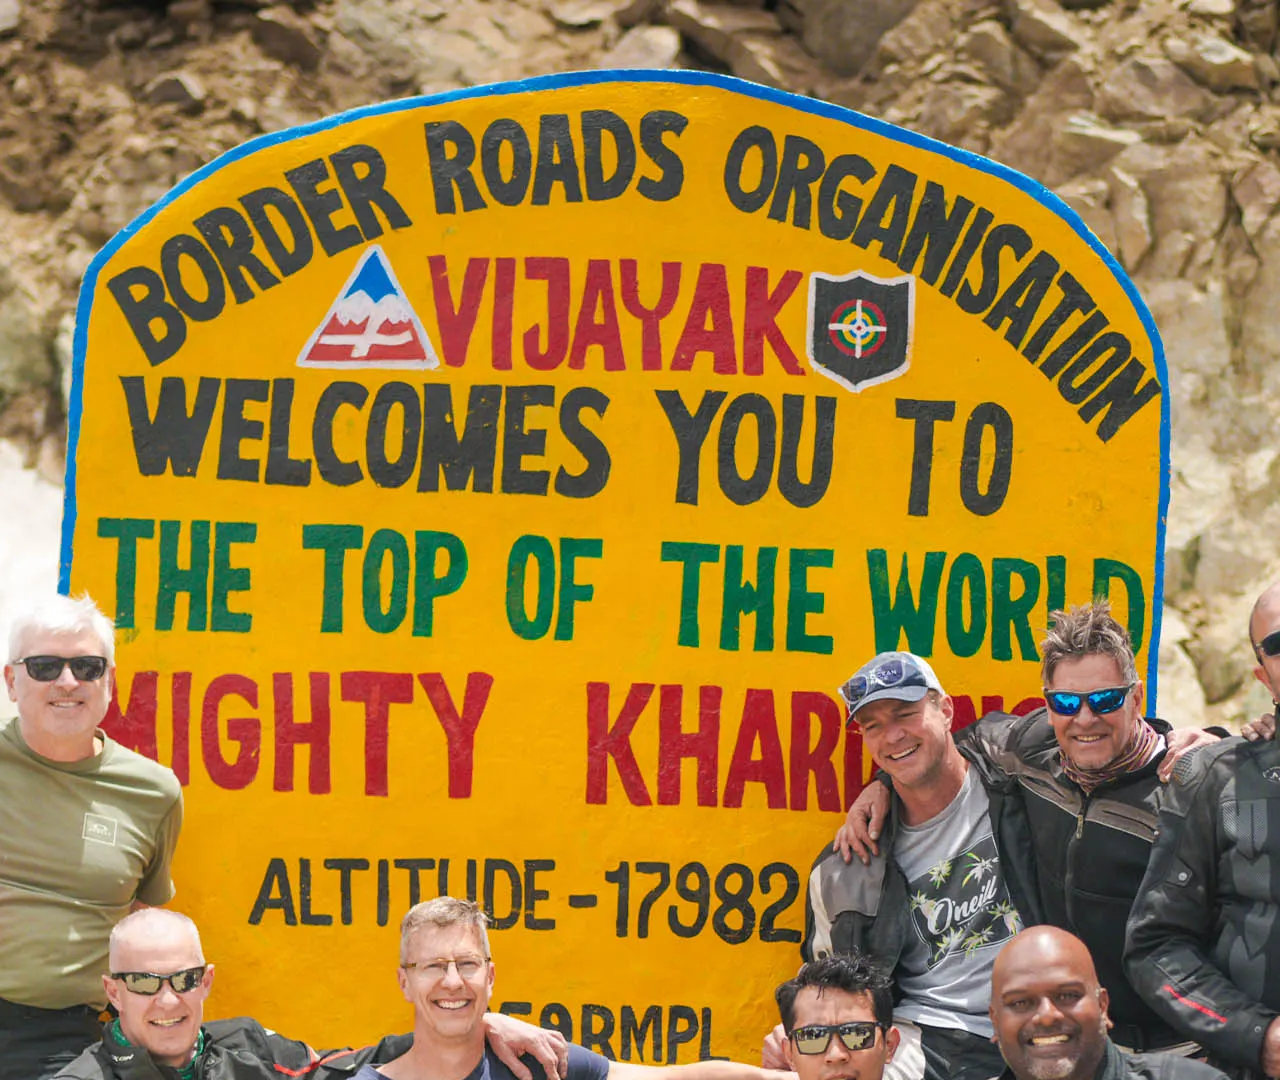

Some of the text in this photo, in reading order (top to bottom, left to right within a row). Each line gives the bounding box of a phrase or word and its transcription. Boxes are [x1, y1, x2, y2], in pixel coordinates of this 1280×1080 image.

[106, 109, 1163, 442] BORDER ROADS ORGANISATION
[426, 255, 806, 377] VIJAYAK
[119, 375, 1013, 517] WELCOMES YOU TO
[96, 517, 258, 633] THE
[302, 523, 468, 638] TOP
[505, 534, 604, 641] OF
[661, 541, 835, 655] THE
[99, 671, 494, 799] MIGHTY
